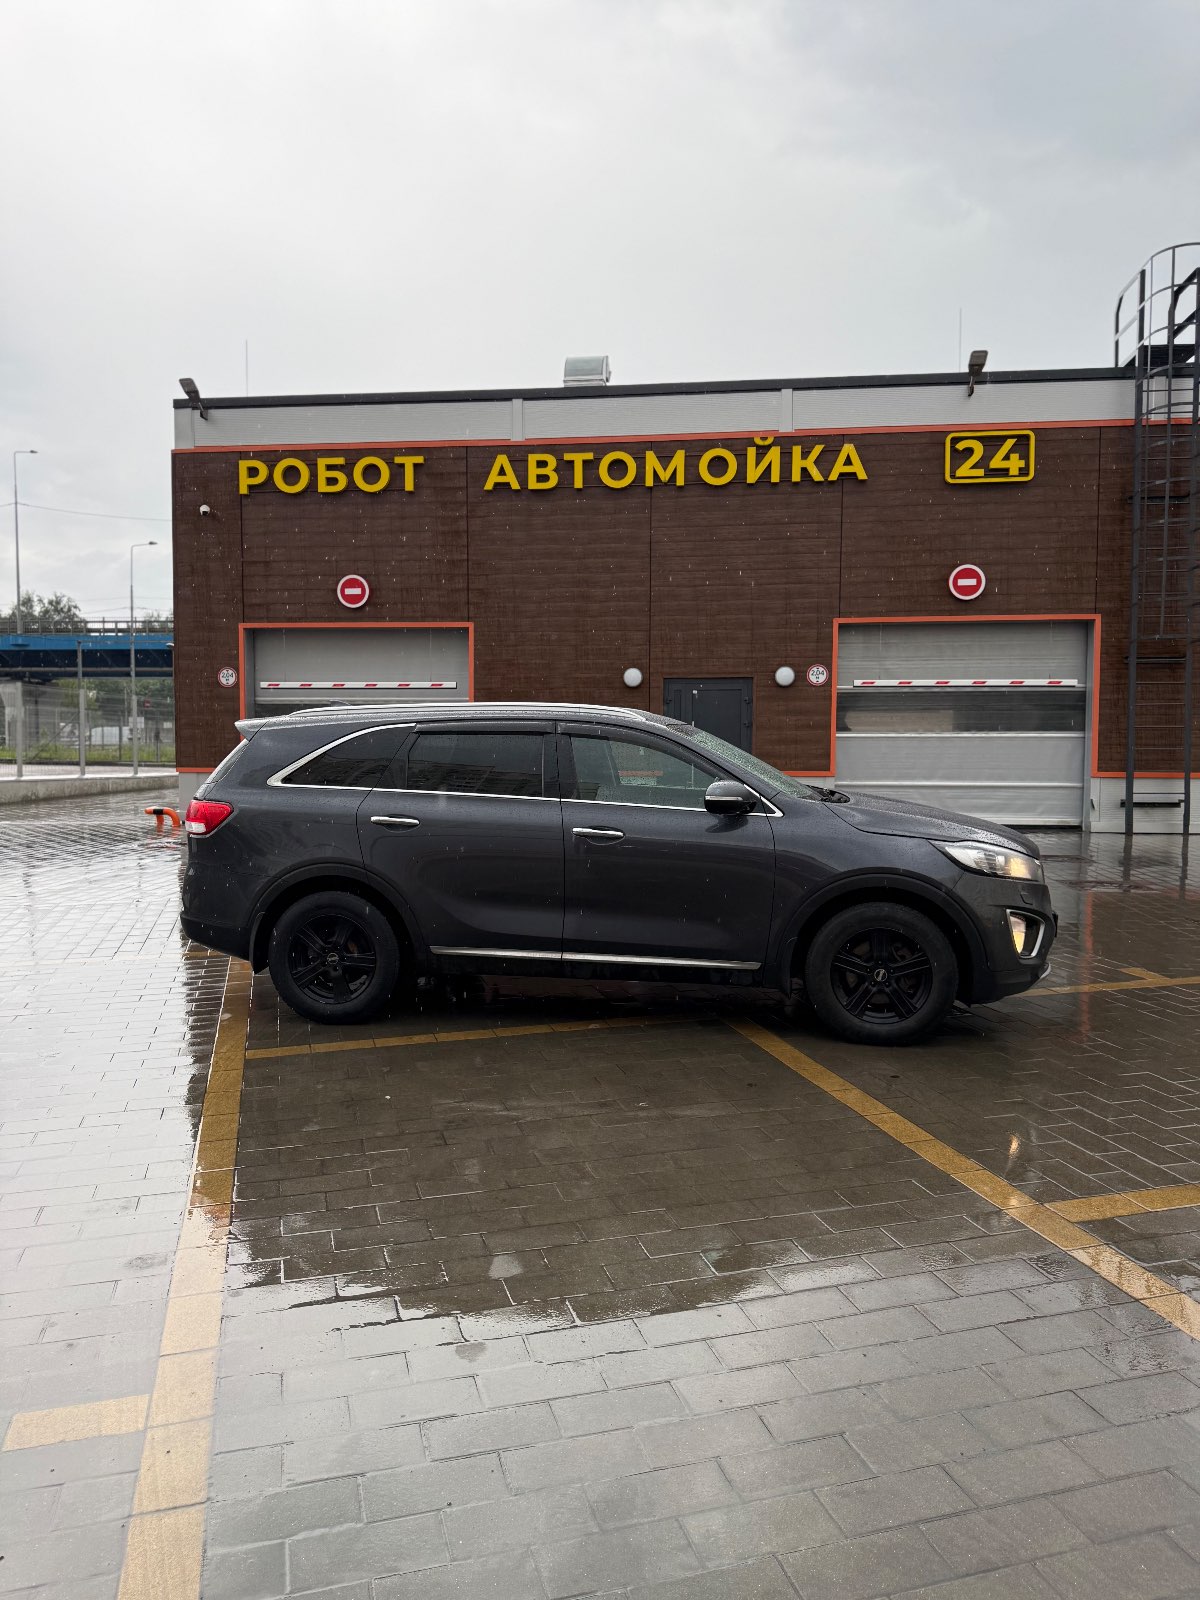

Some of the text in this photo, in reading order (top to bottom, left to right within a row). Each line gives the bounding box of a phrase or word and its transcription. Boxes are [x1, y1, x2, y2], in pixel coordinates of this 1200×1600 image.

[238, 436, 1026, 495] РОБОТ АВТОМОЙКА 24
